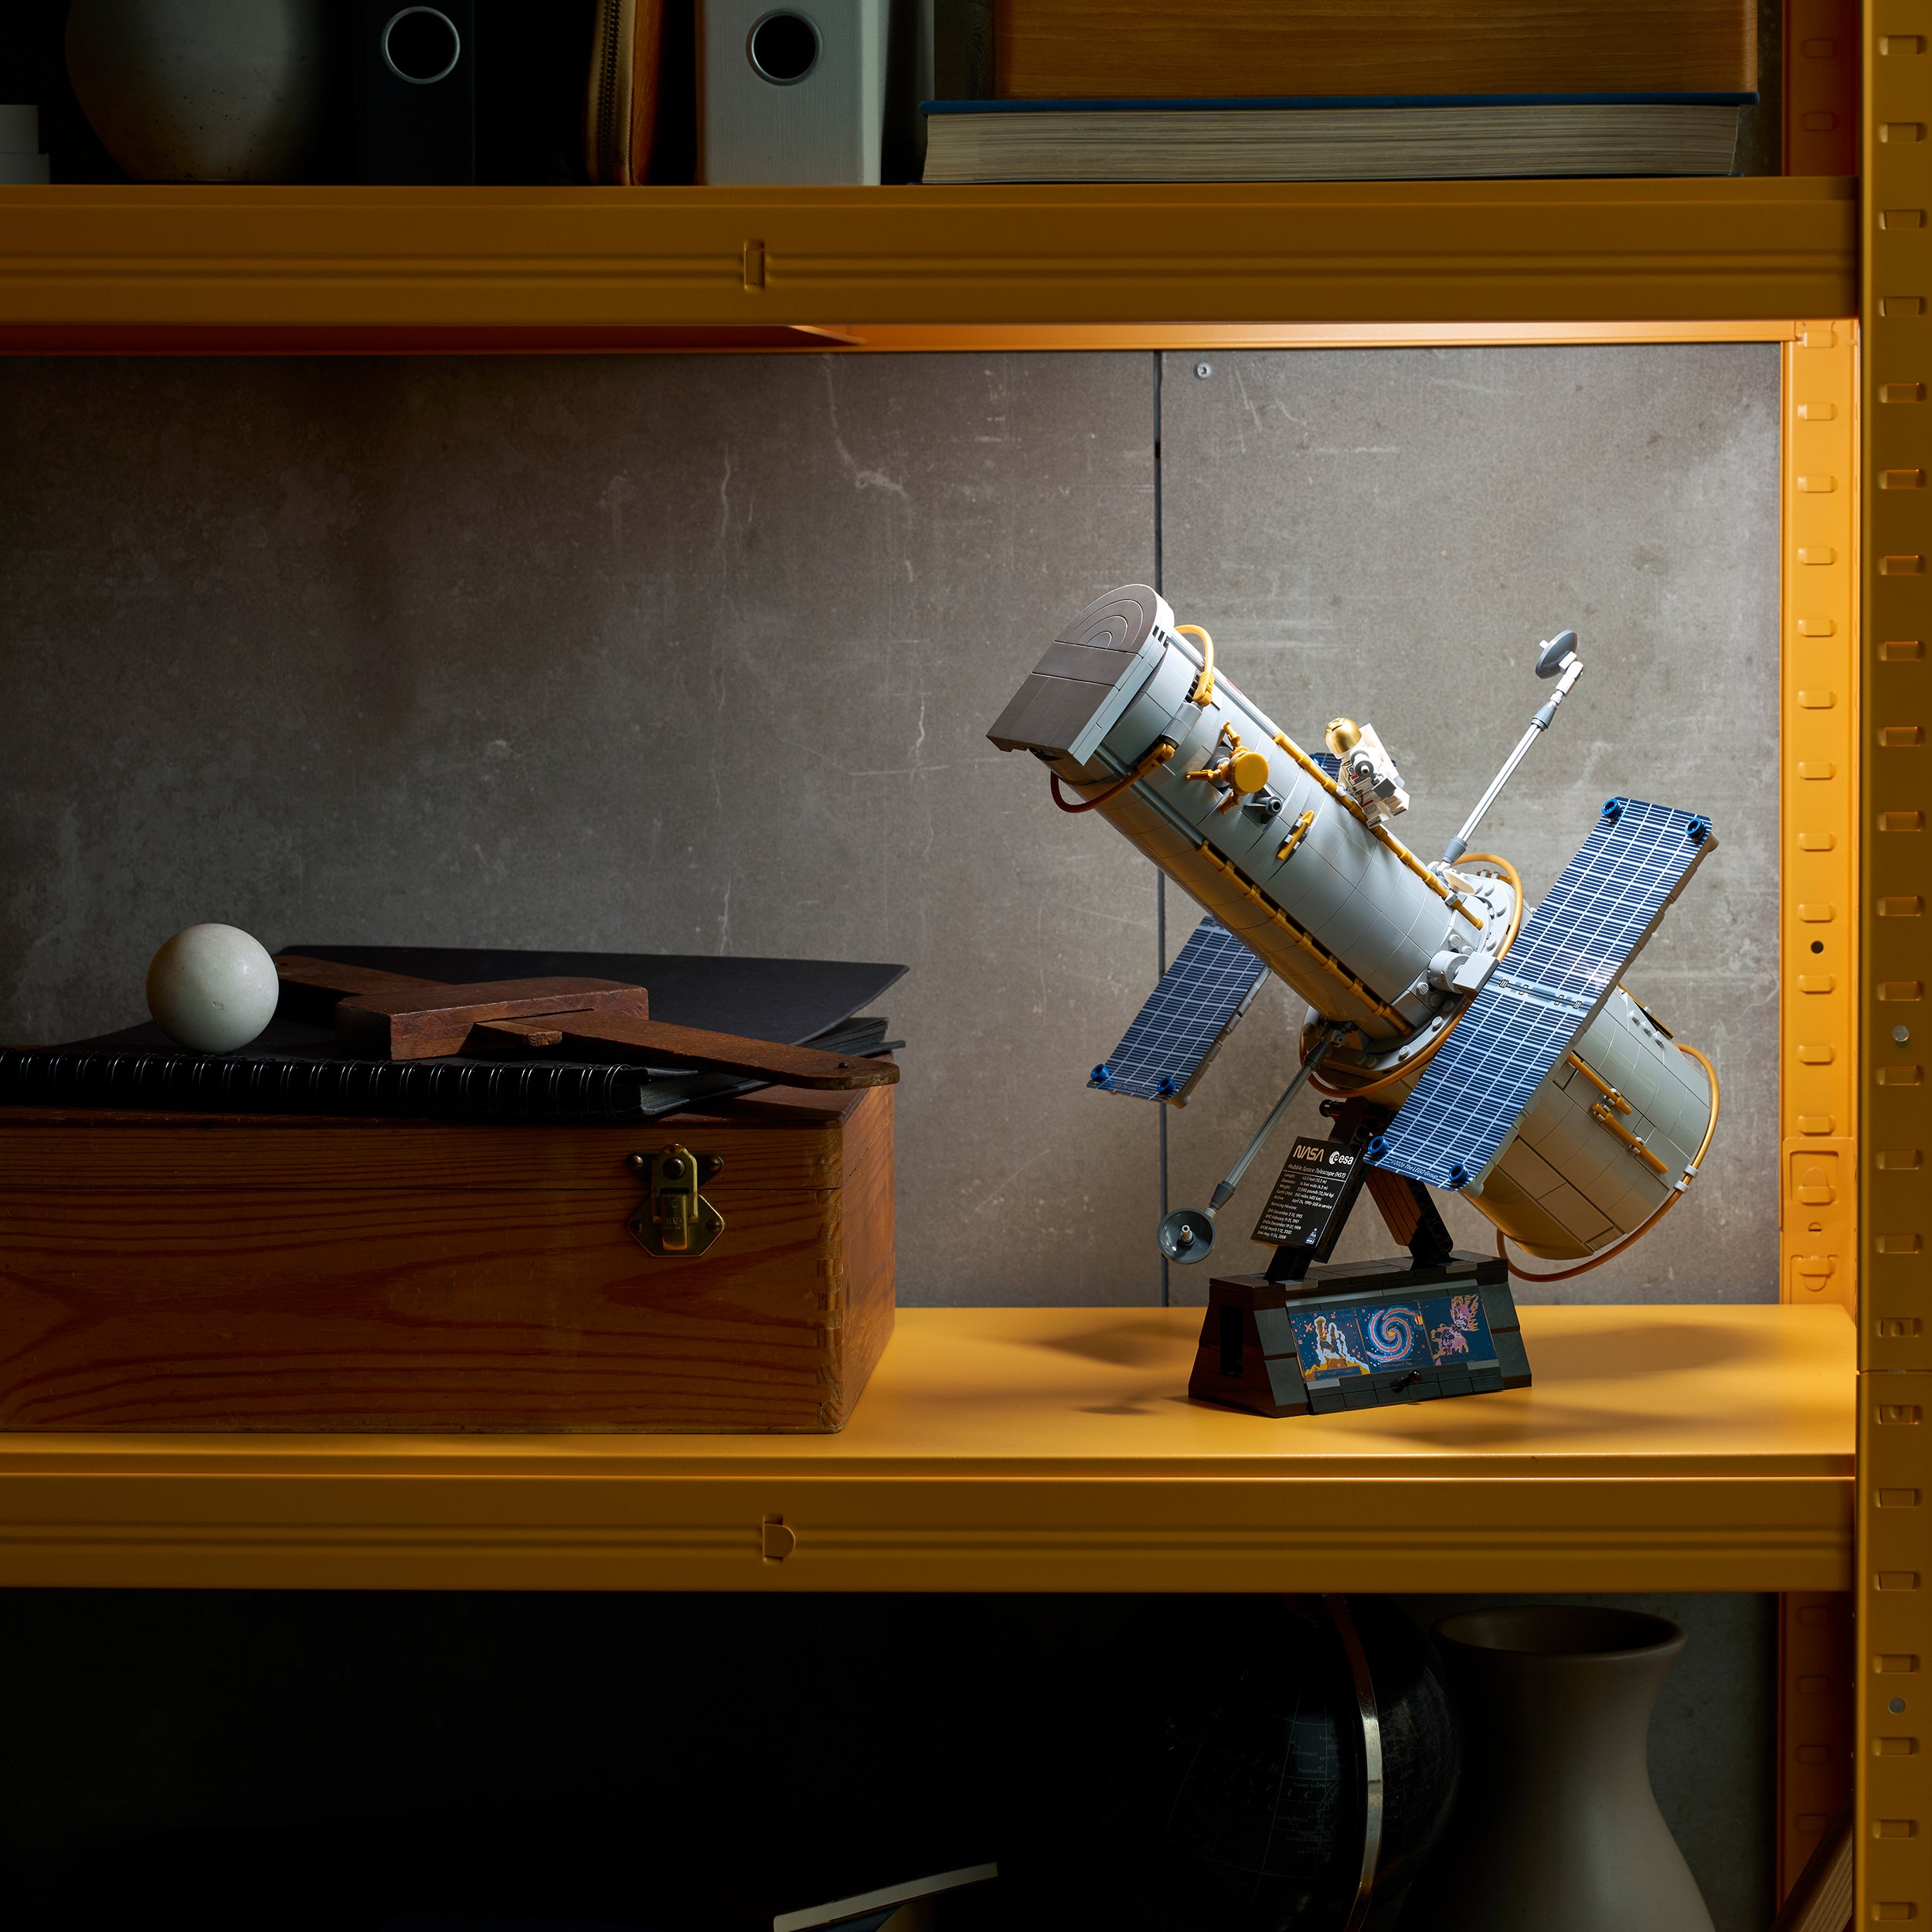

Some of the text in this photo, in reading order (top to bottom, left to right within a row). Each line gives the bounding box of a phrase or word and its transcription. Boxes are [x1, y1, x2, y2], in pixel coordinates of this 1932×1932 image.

[1293, 1145, 1325, 1162] NASA
[1338, 1155, 1354, 1165] esa
[1315, 1168, 1335, 1177] Telescope
[1425, 1171, 1438, 1179] Group
